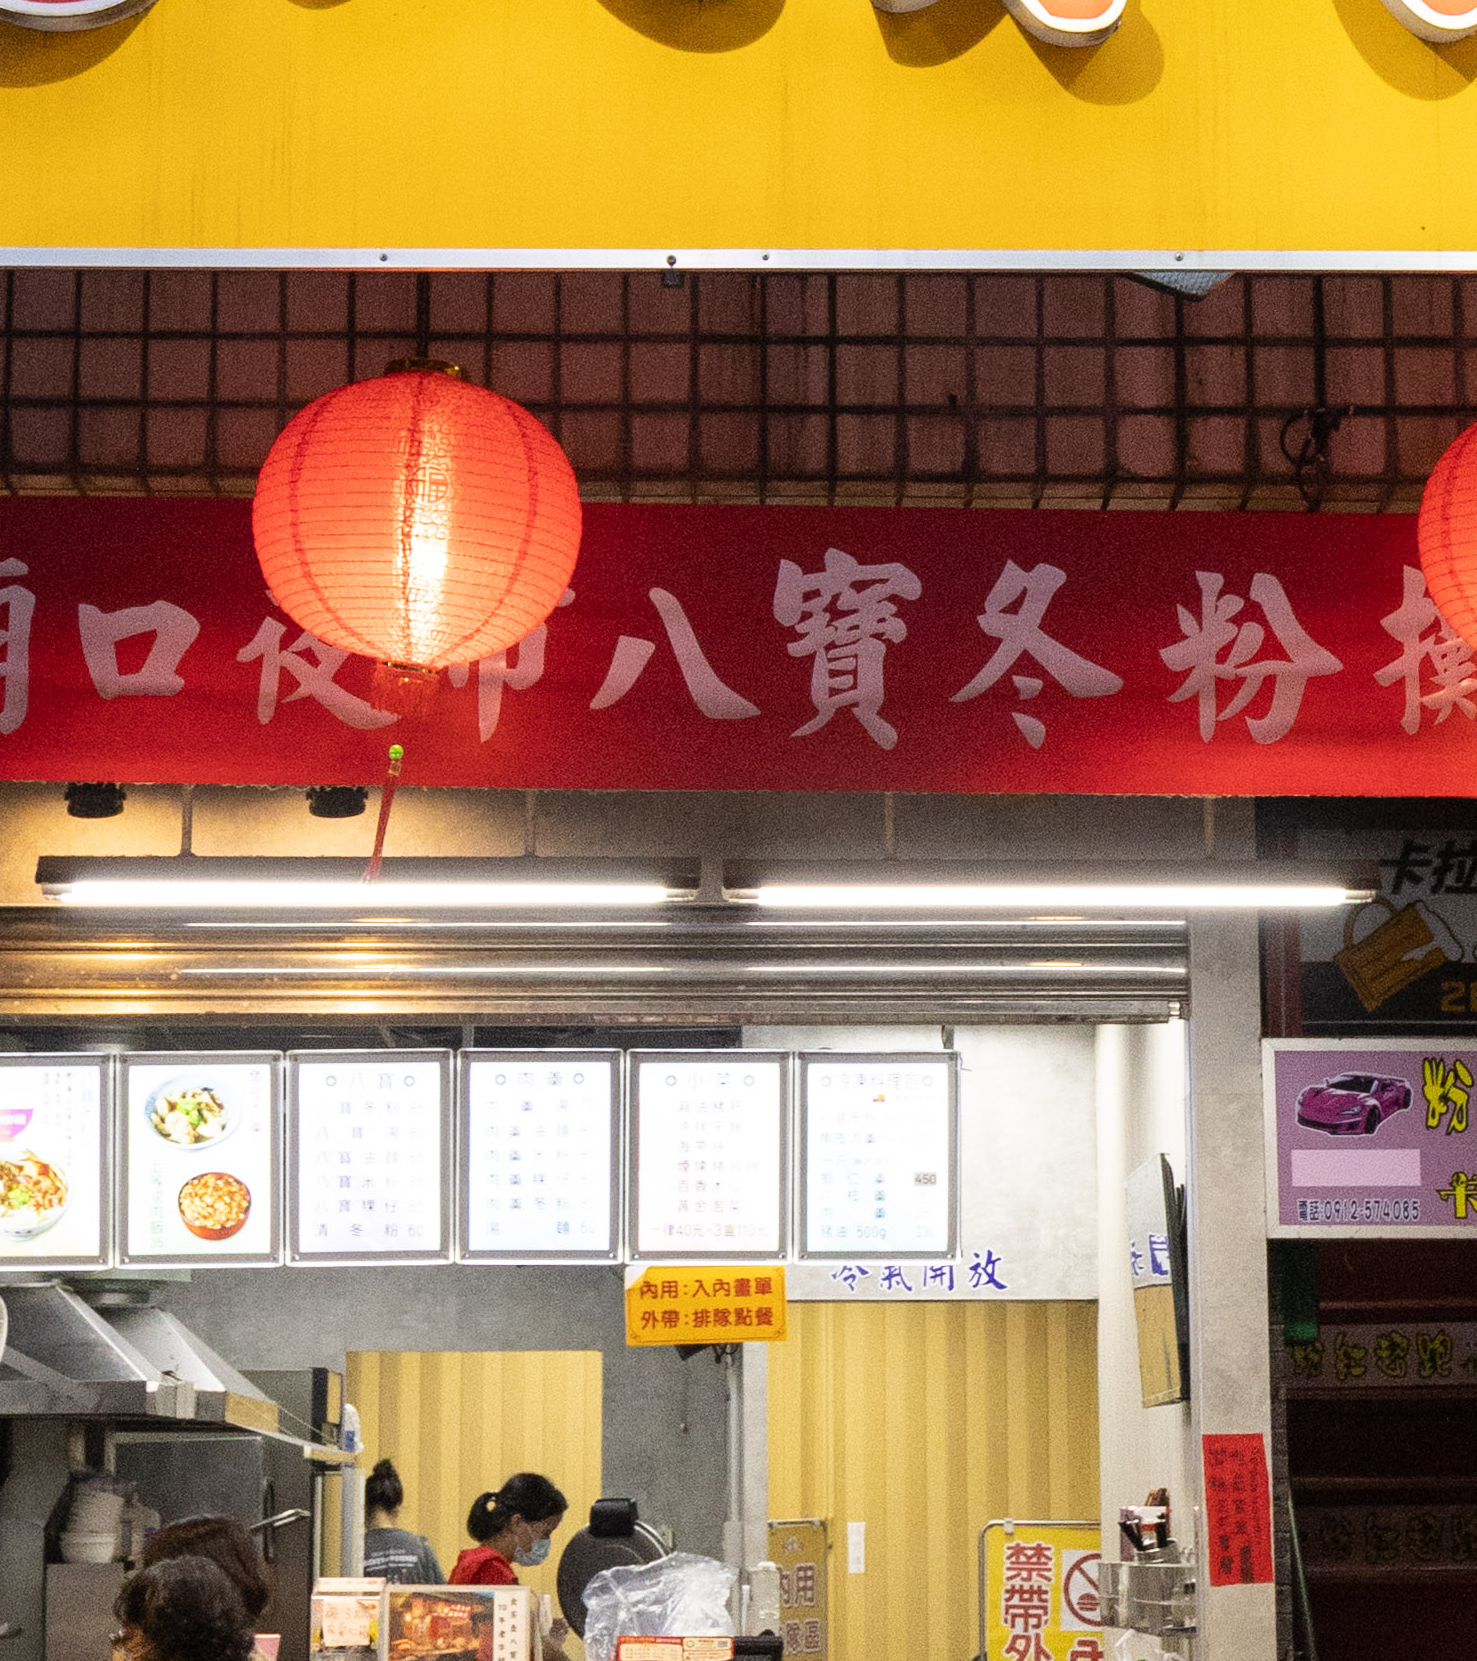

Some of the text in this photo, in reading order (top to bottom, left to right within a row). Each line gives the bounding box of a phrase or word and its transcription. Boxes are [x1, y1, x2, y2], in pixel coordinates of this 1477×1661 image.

[639, 1276, 774, 1300] 內用:入內畫單
[639, 1306, 774, 1330] 外帶:排隊點餐
